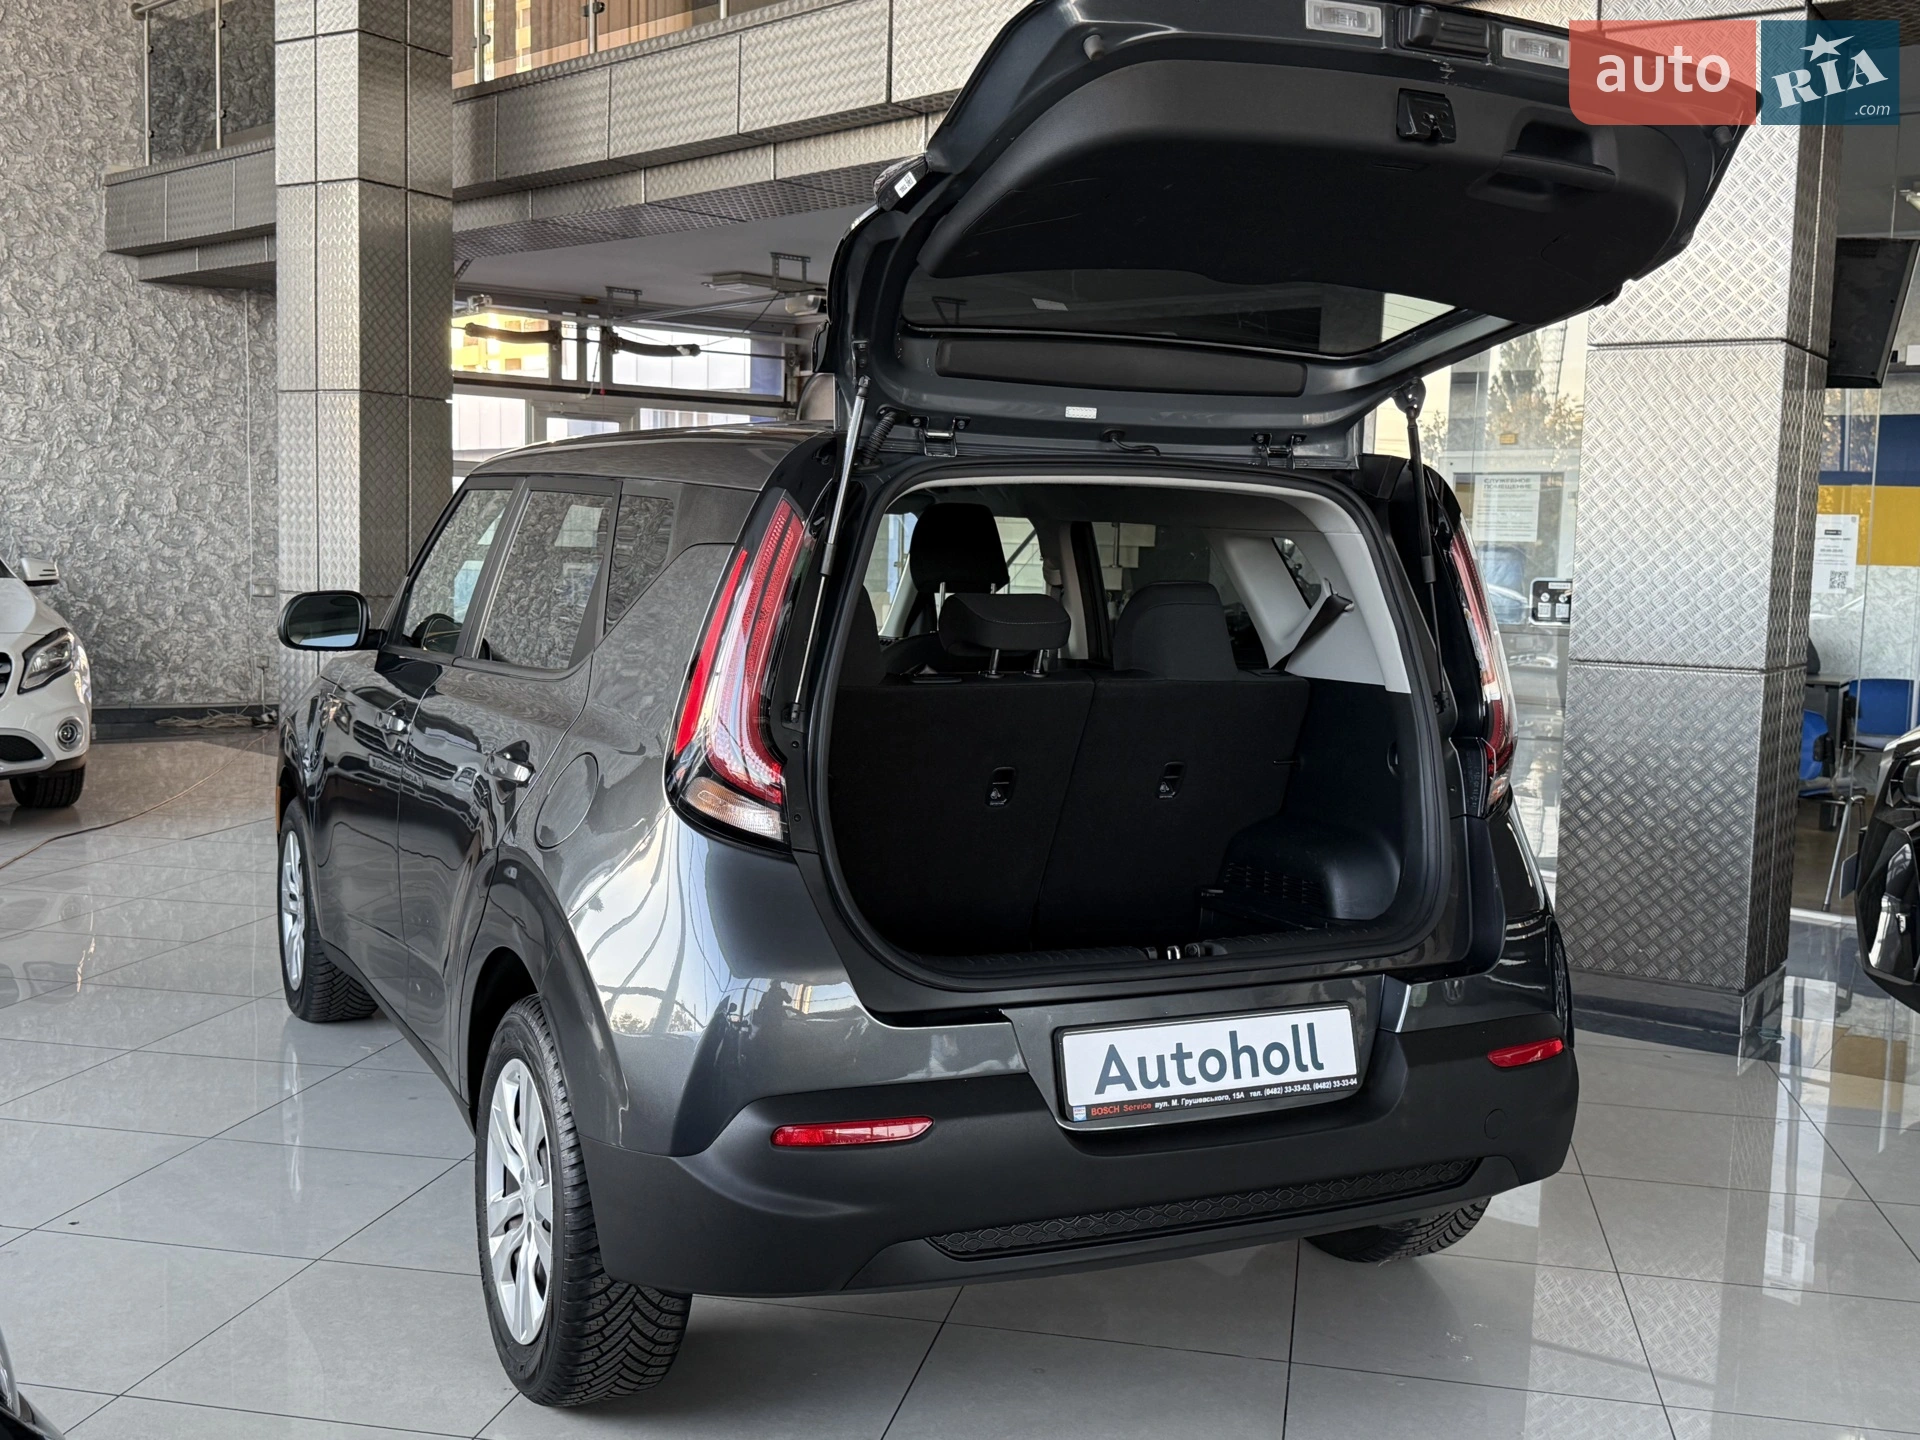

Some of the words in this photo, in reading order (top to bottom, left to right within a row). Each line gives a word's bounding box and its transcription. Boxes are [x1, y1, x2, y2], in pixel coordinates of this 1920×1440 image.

[1094, 1022, 1325, 1096] Autoholl
[1091, 1105, 1120, 1116] BOSCH
[1123, 1102, 1152, 1112] Service
[1154, 1100, 1170, 1110] вул.
[1181, 1094, 1231, 1107] Грушевського,
[1249, 1090, 1263, 1098] тел.
[1264, 1087, 1284, 1097] (0482)
[1284, 1084, 1312, 1094] 33-33-03,
[1313, 1080, 1332, 1091] (0482)
[1332, 1077, 1358, 1088] 33-33-04
